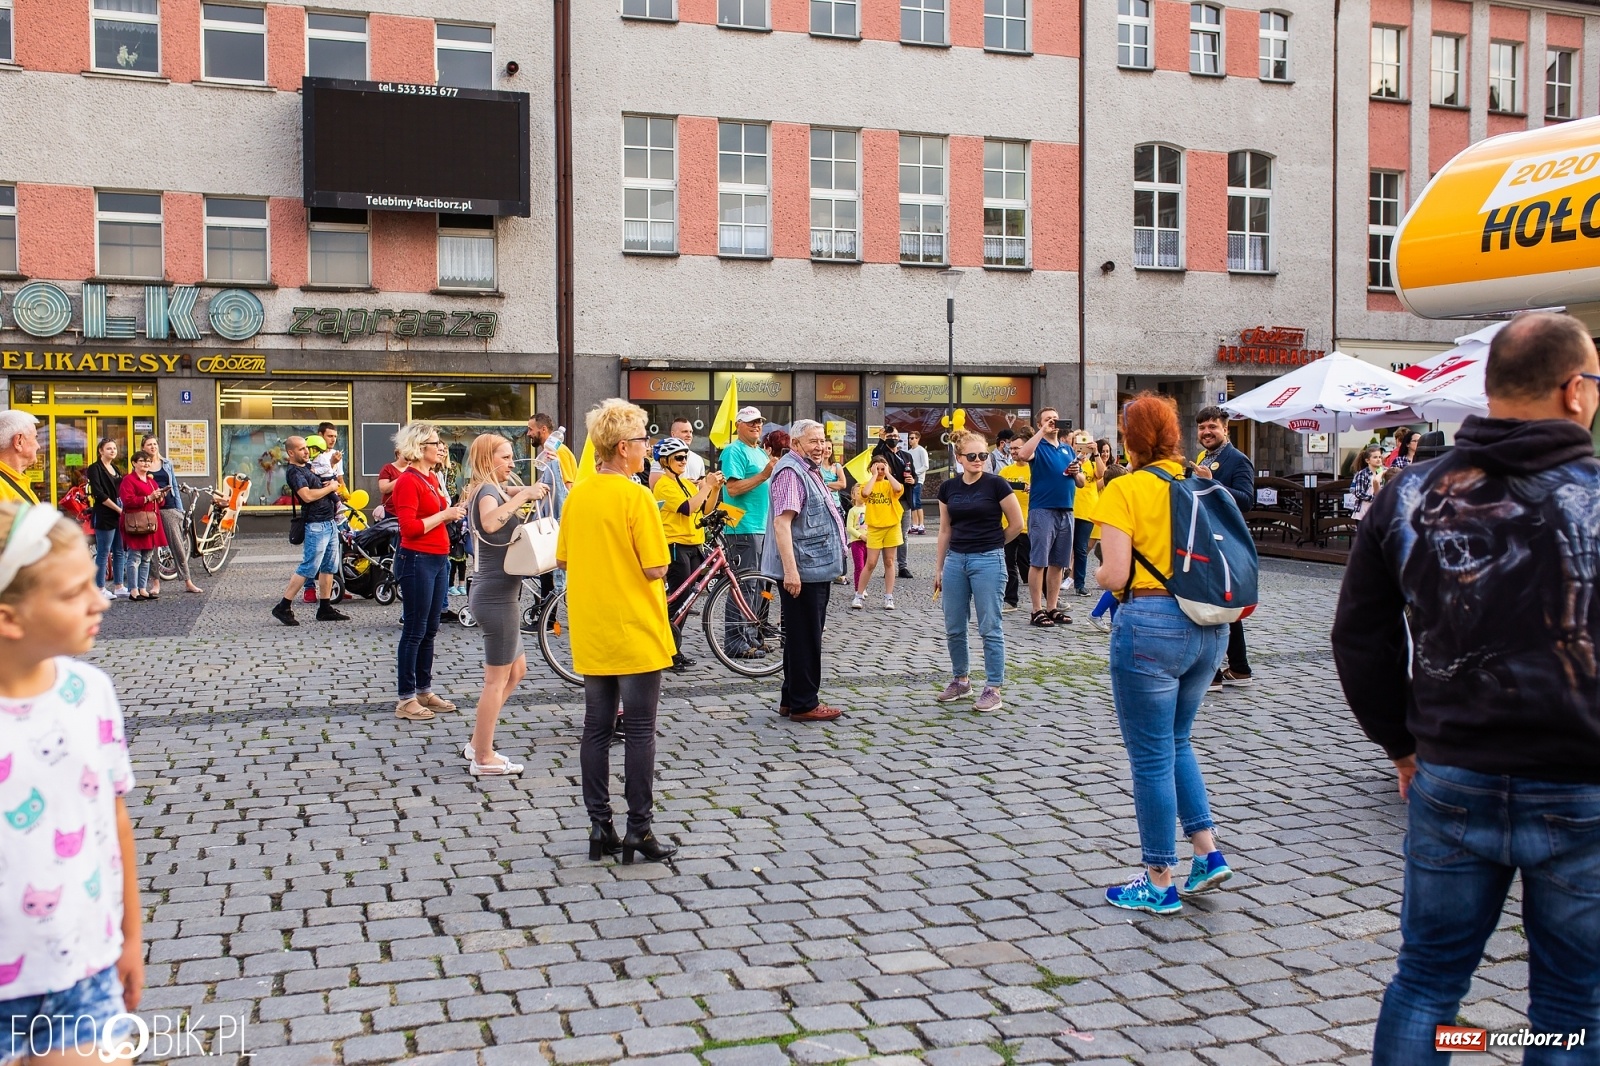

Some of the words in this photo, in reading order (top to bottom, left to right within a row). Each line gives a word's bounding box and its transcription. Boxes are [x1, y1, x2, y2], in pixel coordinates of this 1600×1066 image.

[378, 83, 395, 93] tel.
[398, 84, 417, 94] 533
[418, 85, 438, 96] 355
[439, 86, 459, 98] 677
[1508, 151, 1600, 187] 2020
[365, 195, 473, 212] Telebimy-Raciborz.pl
[0, 281, 265, 341] OLKO
[287, 306, 498, 344] zaprasza
[649, 377, 696, 393] Ciasta
[972, 380, 1018, 402] Napoje
[183, 391, 190, 401] 6
